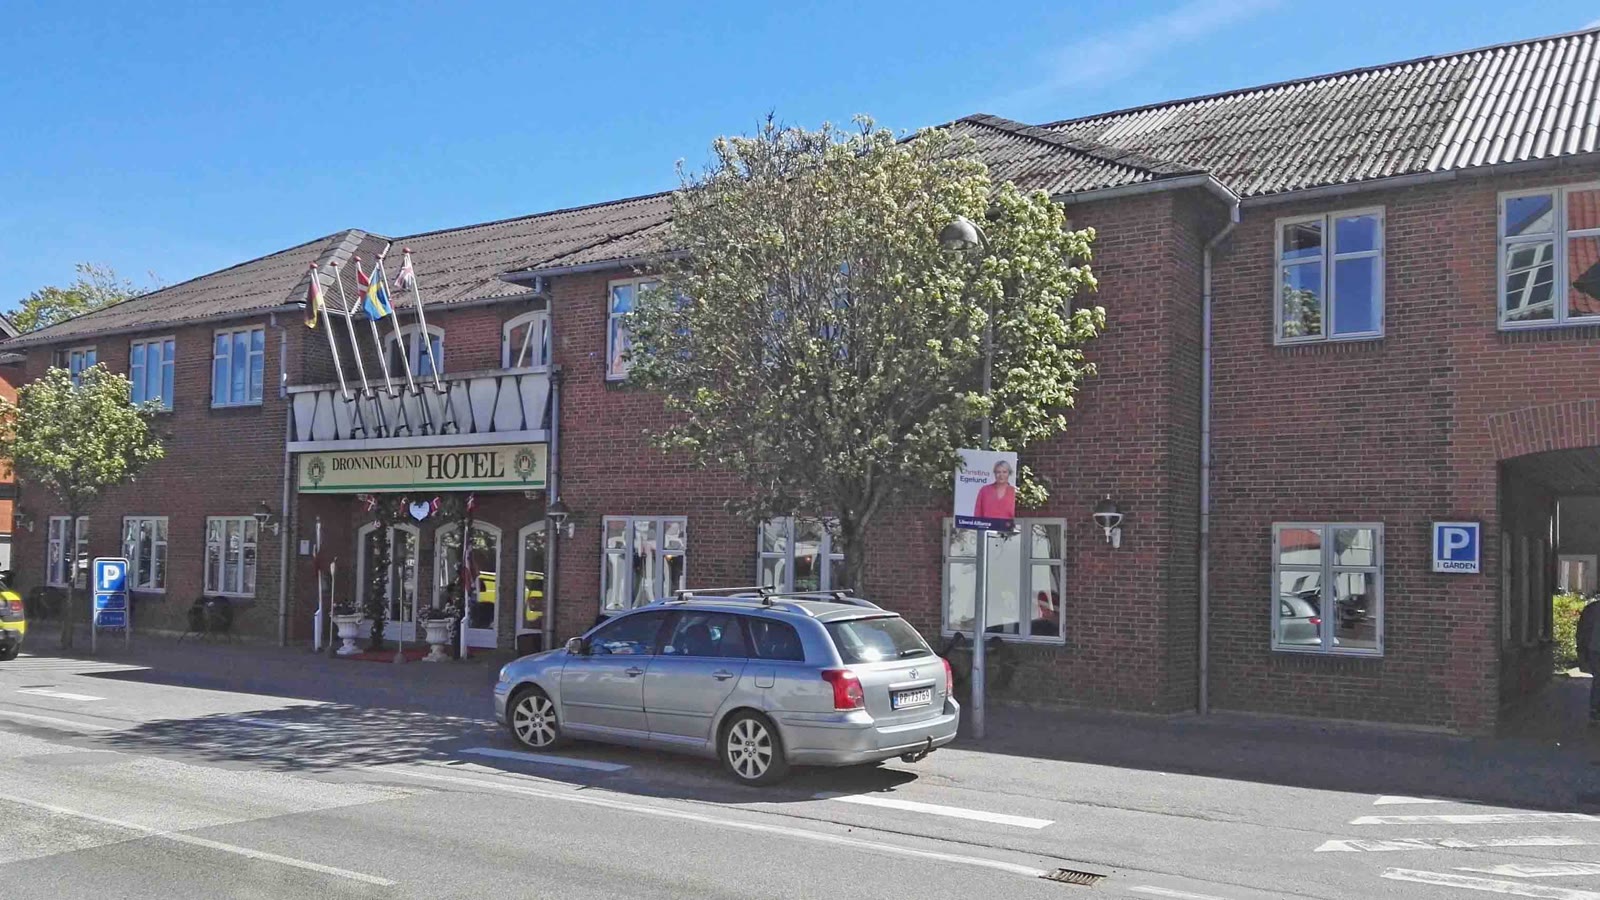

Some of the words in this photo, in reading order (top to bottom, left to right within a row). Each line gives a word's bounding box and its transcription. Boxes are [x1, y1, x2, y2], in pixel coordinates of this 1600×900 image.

[332, 454, 422, 471] DRONNINGLUND
[425, 451, 505, 480] HOTEL
[960, 475, 987, 484] Egelund
[1443, 527, 1470, 559] P
[103, 564, 120, 589] P
